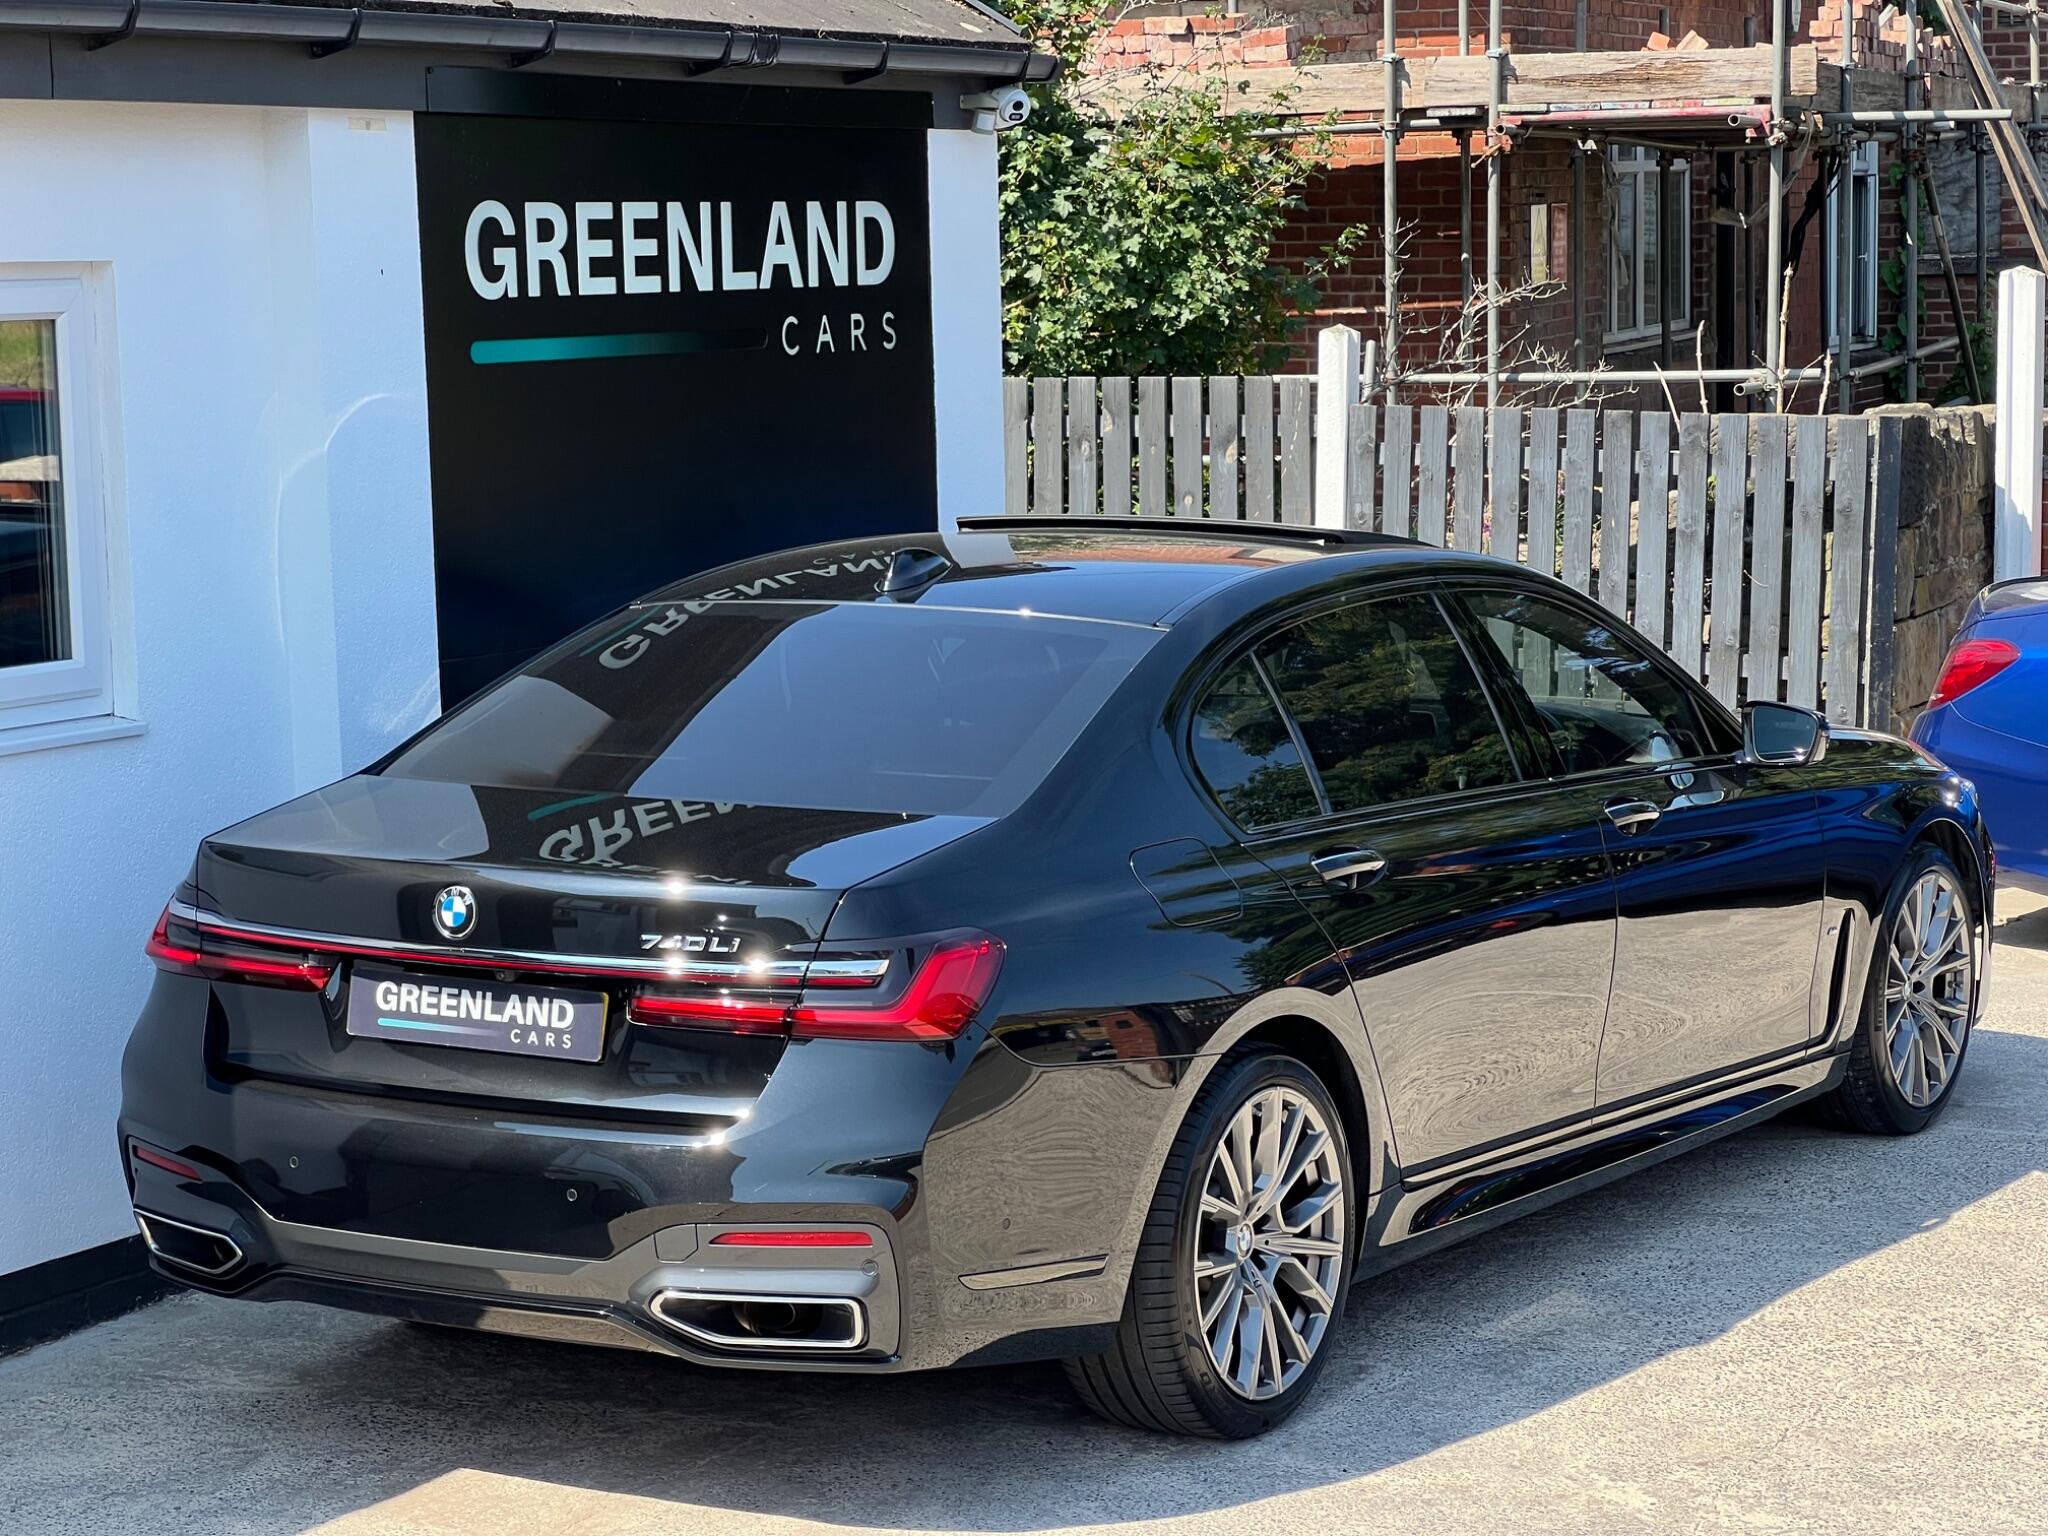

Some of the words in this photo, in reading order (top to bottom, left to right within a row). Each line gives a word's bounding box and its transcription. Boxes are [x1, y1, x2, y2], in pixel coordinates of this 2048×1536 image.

[464, 199, 896, 300] GREENLAND
[781, 311, 897, 356] CARS
[375, 981, 576, 1029] GREENLAND
[510, 1028, 572, 1049] CARS
